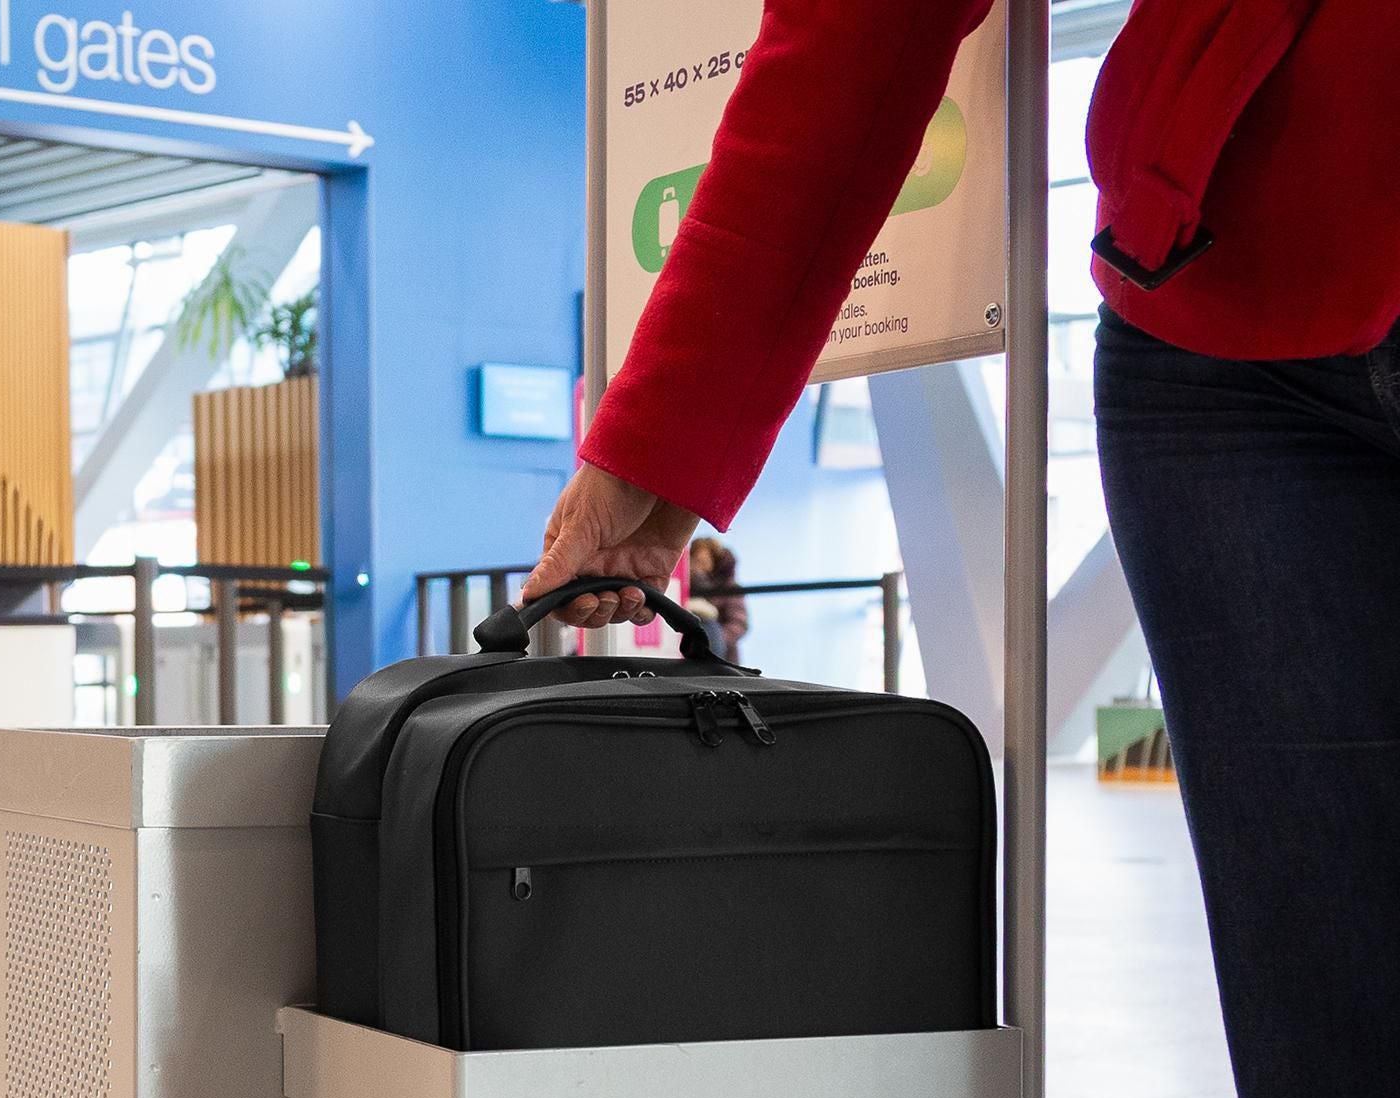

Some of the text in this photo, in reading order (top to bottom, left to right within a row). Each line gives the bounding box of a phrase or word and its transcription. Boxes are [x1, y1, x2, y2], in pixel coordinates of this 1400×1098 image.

[33, 10, 217, 95] gates
[623, 50, 749, 108] 55 x 40 x 25 c
[839, 324, 862, 344] your
[864, 315, 908, 333] booking
